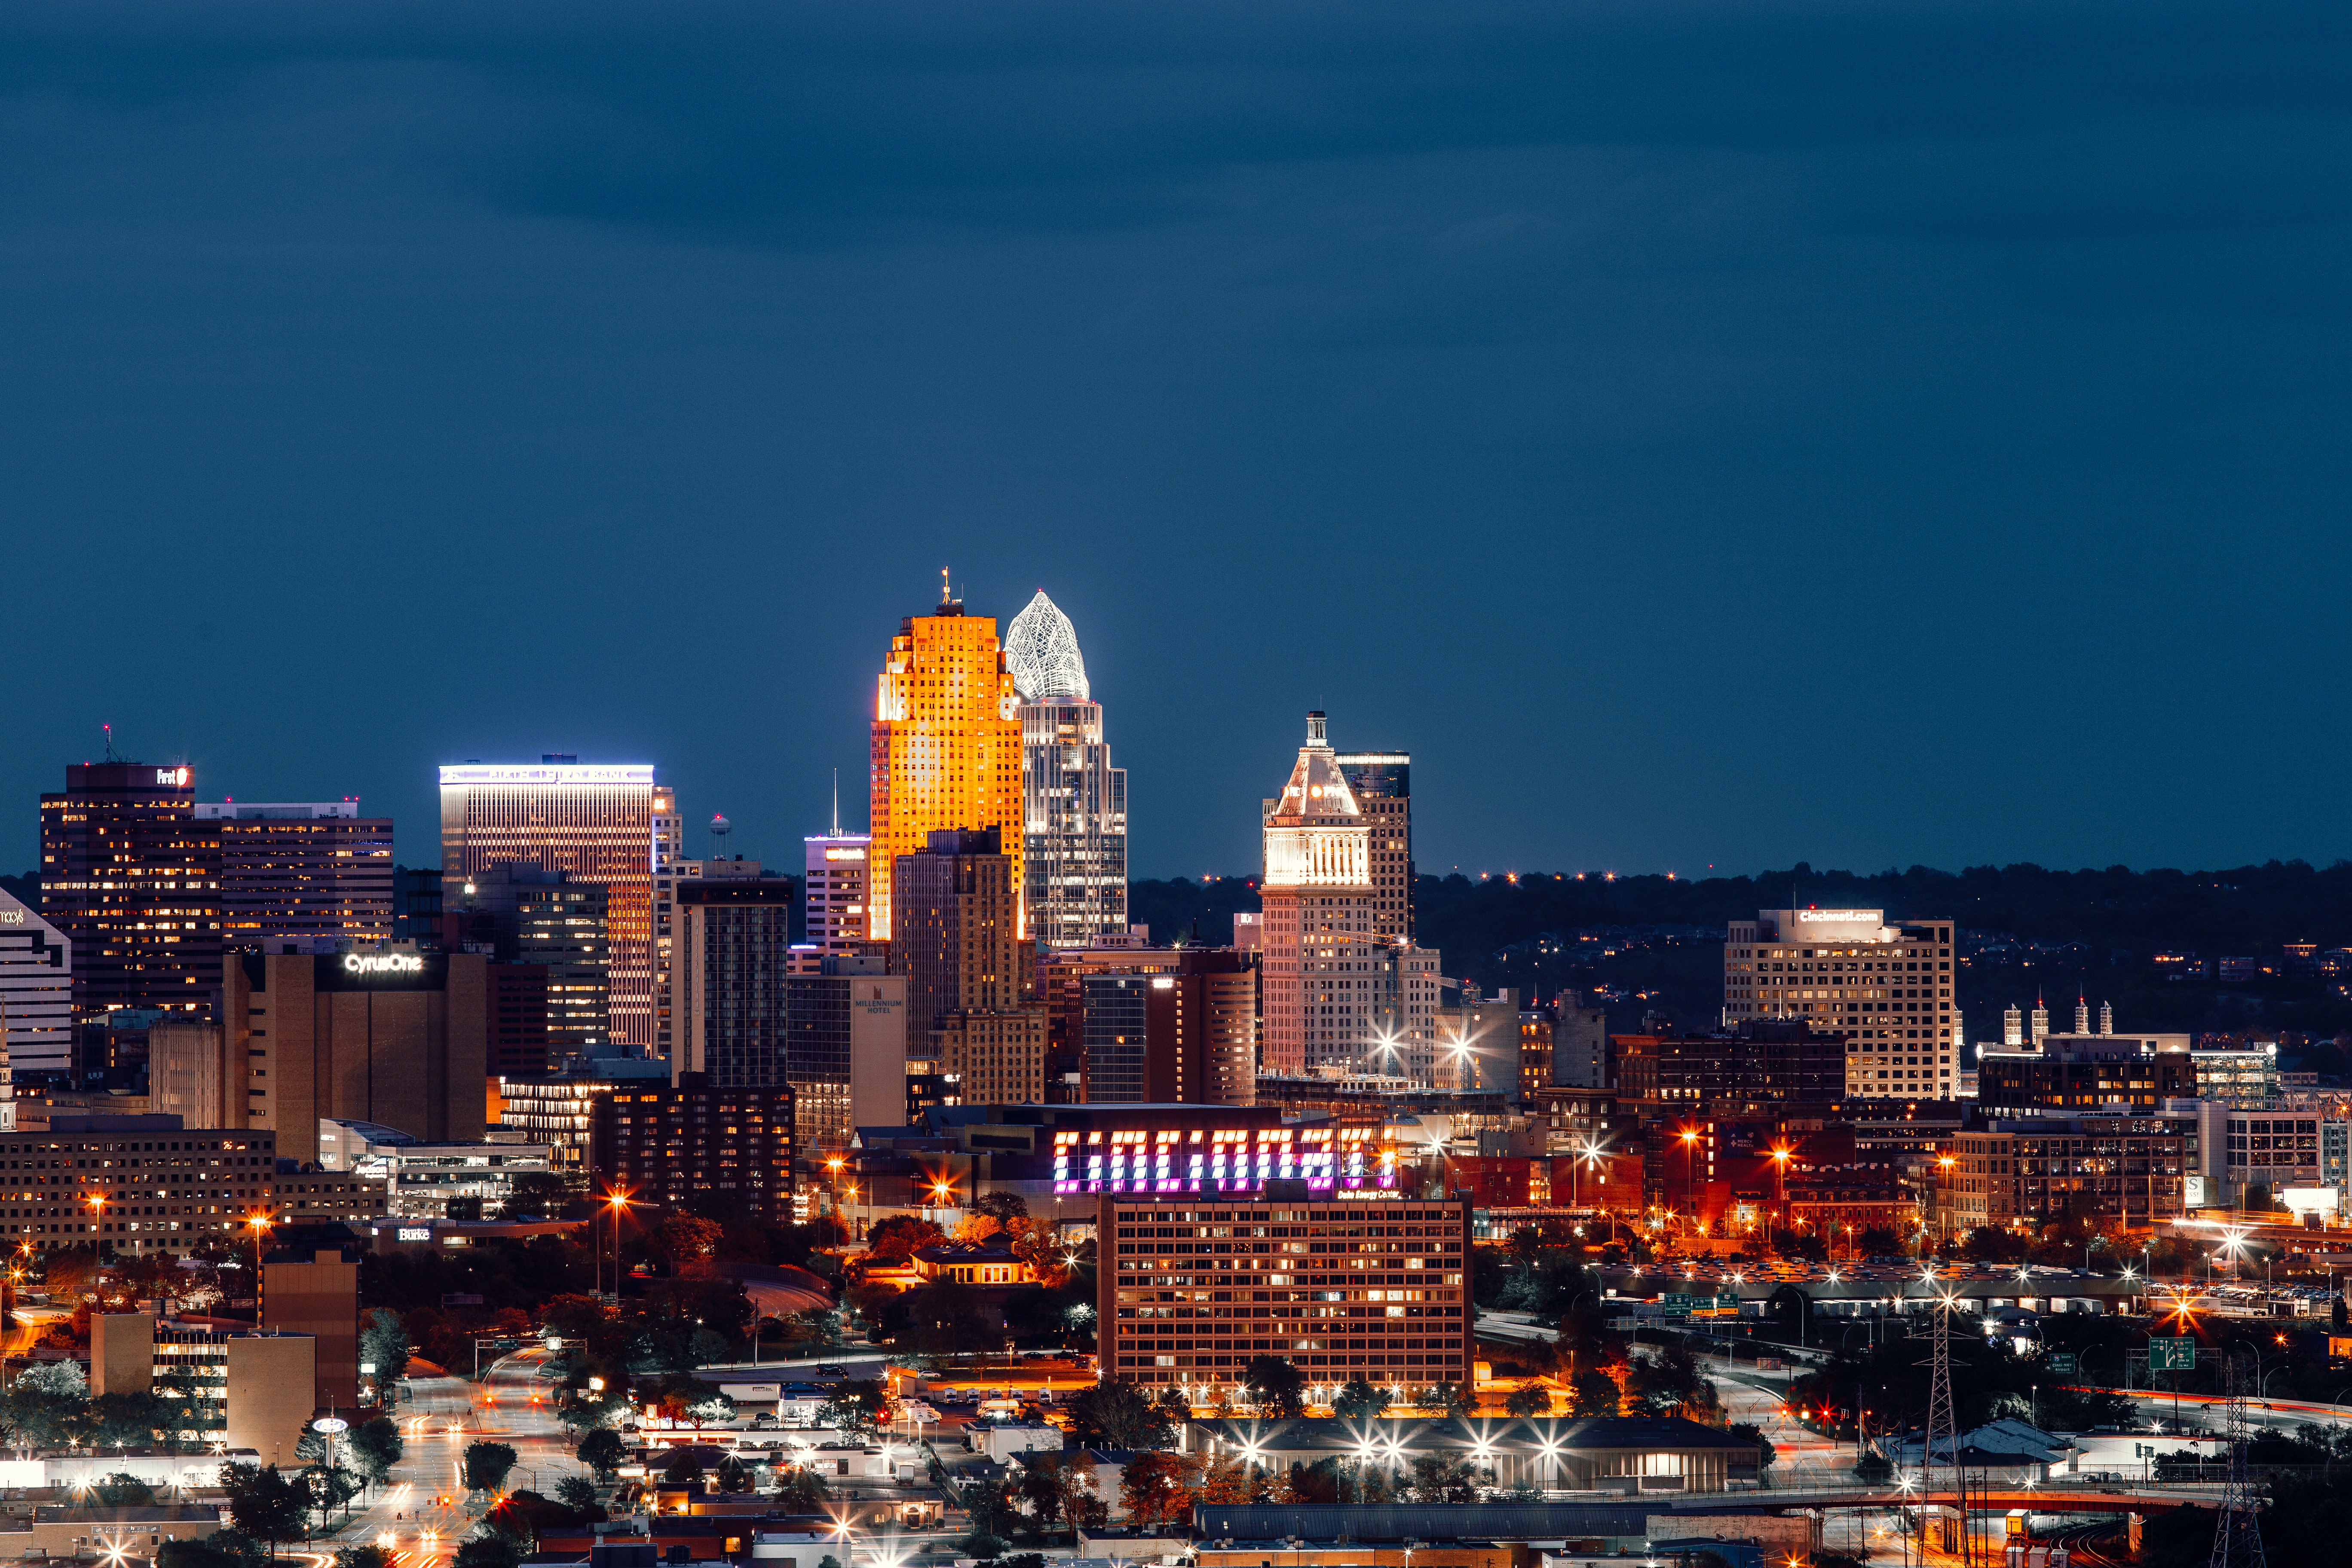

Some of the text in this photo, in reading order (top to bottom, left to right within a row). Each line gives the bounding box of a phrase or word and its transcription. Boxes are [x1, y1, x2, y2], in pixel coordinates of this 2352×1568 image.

[157, 769, 175, 784] First
[489, 769, 630, 779] FIFTH THIRD BANK
[1800, 911, 1878, 922] Cincinnati.com
[345, 954, 422, 974] CyrusOne
[1338, 1189, 1399, 1200] Duke Energy Center
